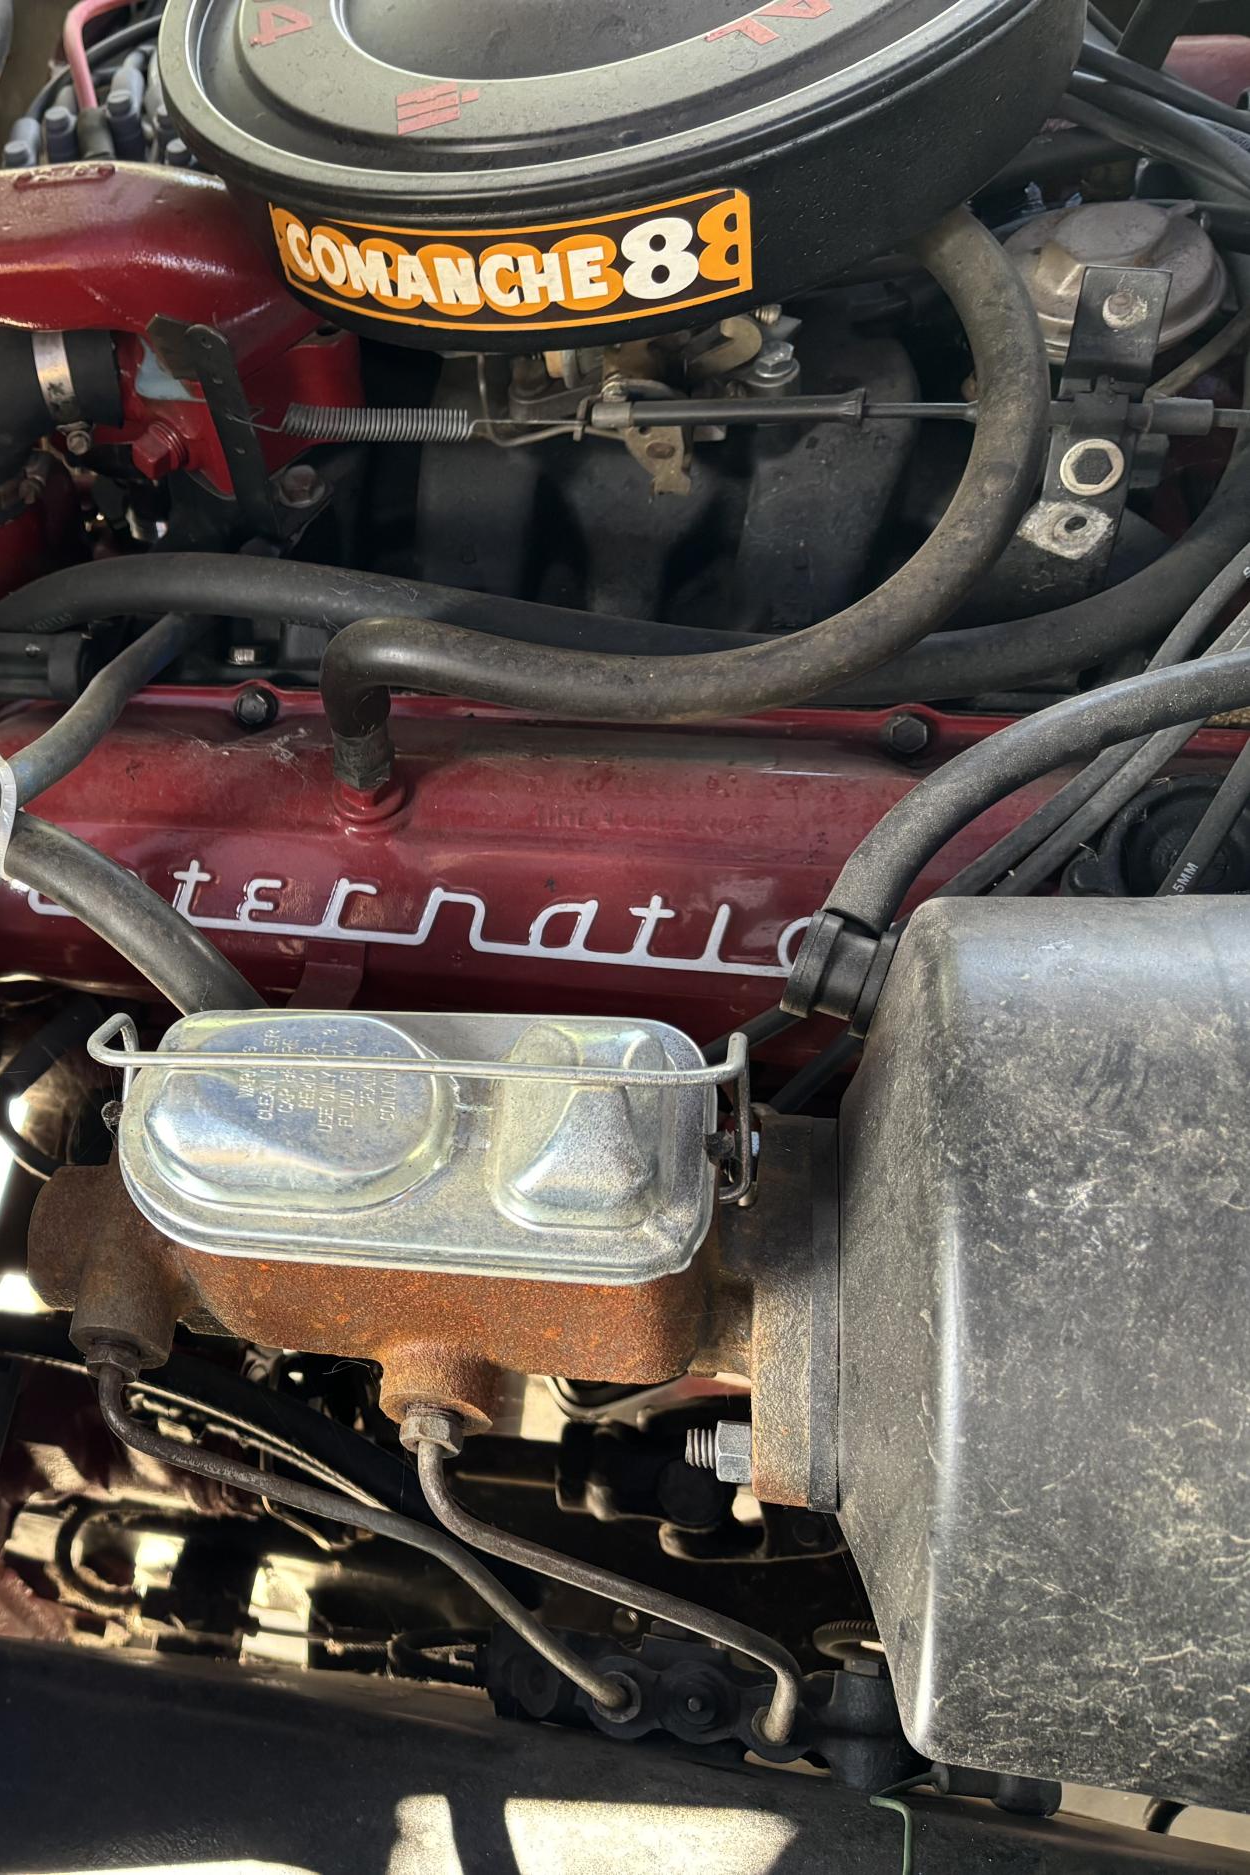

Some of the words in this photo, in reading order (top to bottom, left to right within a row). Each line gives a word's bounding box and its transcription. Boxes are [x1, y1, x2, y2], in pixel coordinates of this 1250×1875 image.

[286, 222, 610, 306] COMANCHE
[317, 1107, 334, 1132] USE
[338, 1089, 356, 1128] FLUID
